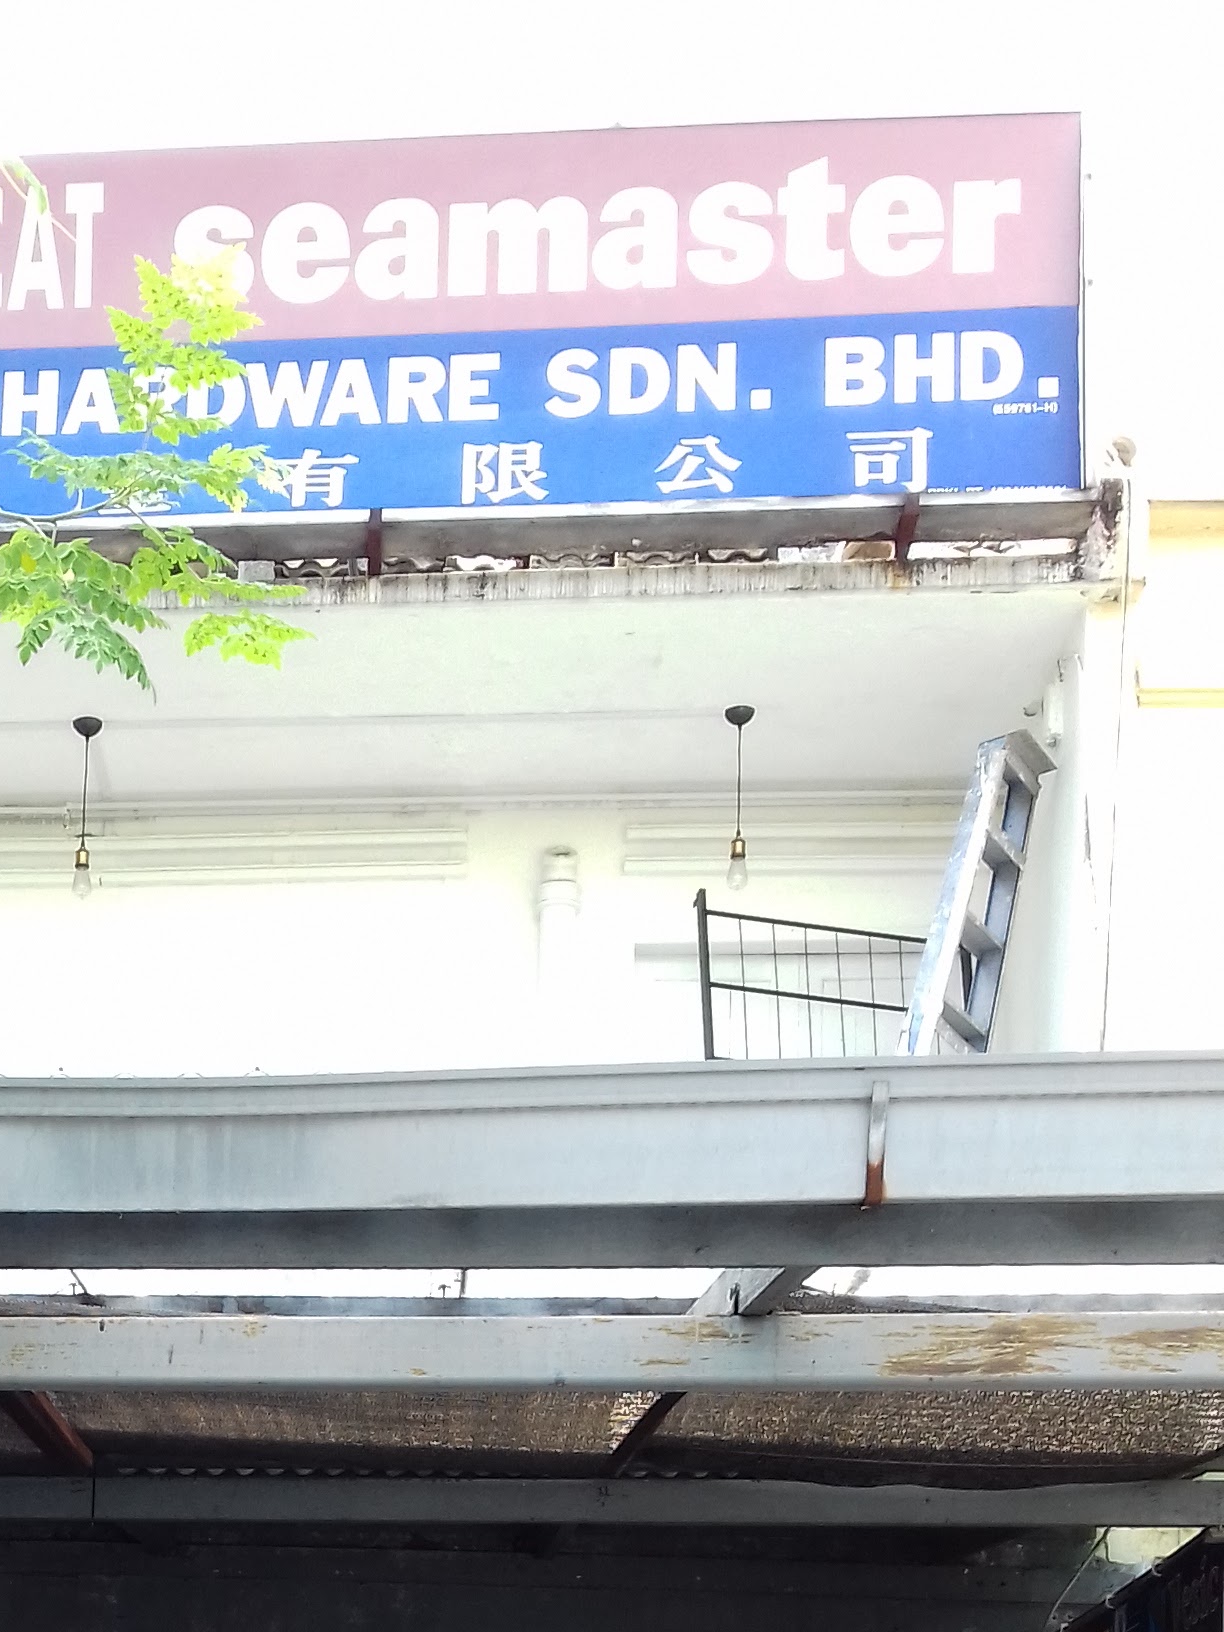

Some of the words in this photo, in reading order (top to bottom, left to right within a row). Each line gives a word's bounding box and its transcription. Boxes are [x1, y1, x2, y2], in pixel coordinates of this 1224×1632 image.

[174, 156, 1020, 305] seamaster
[1, 352, 501, 436] HARDWARE
[545, 341, 772, 419] SDN.
[823, 330, 1060, 406] BHD.
